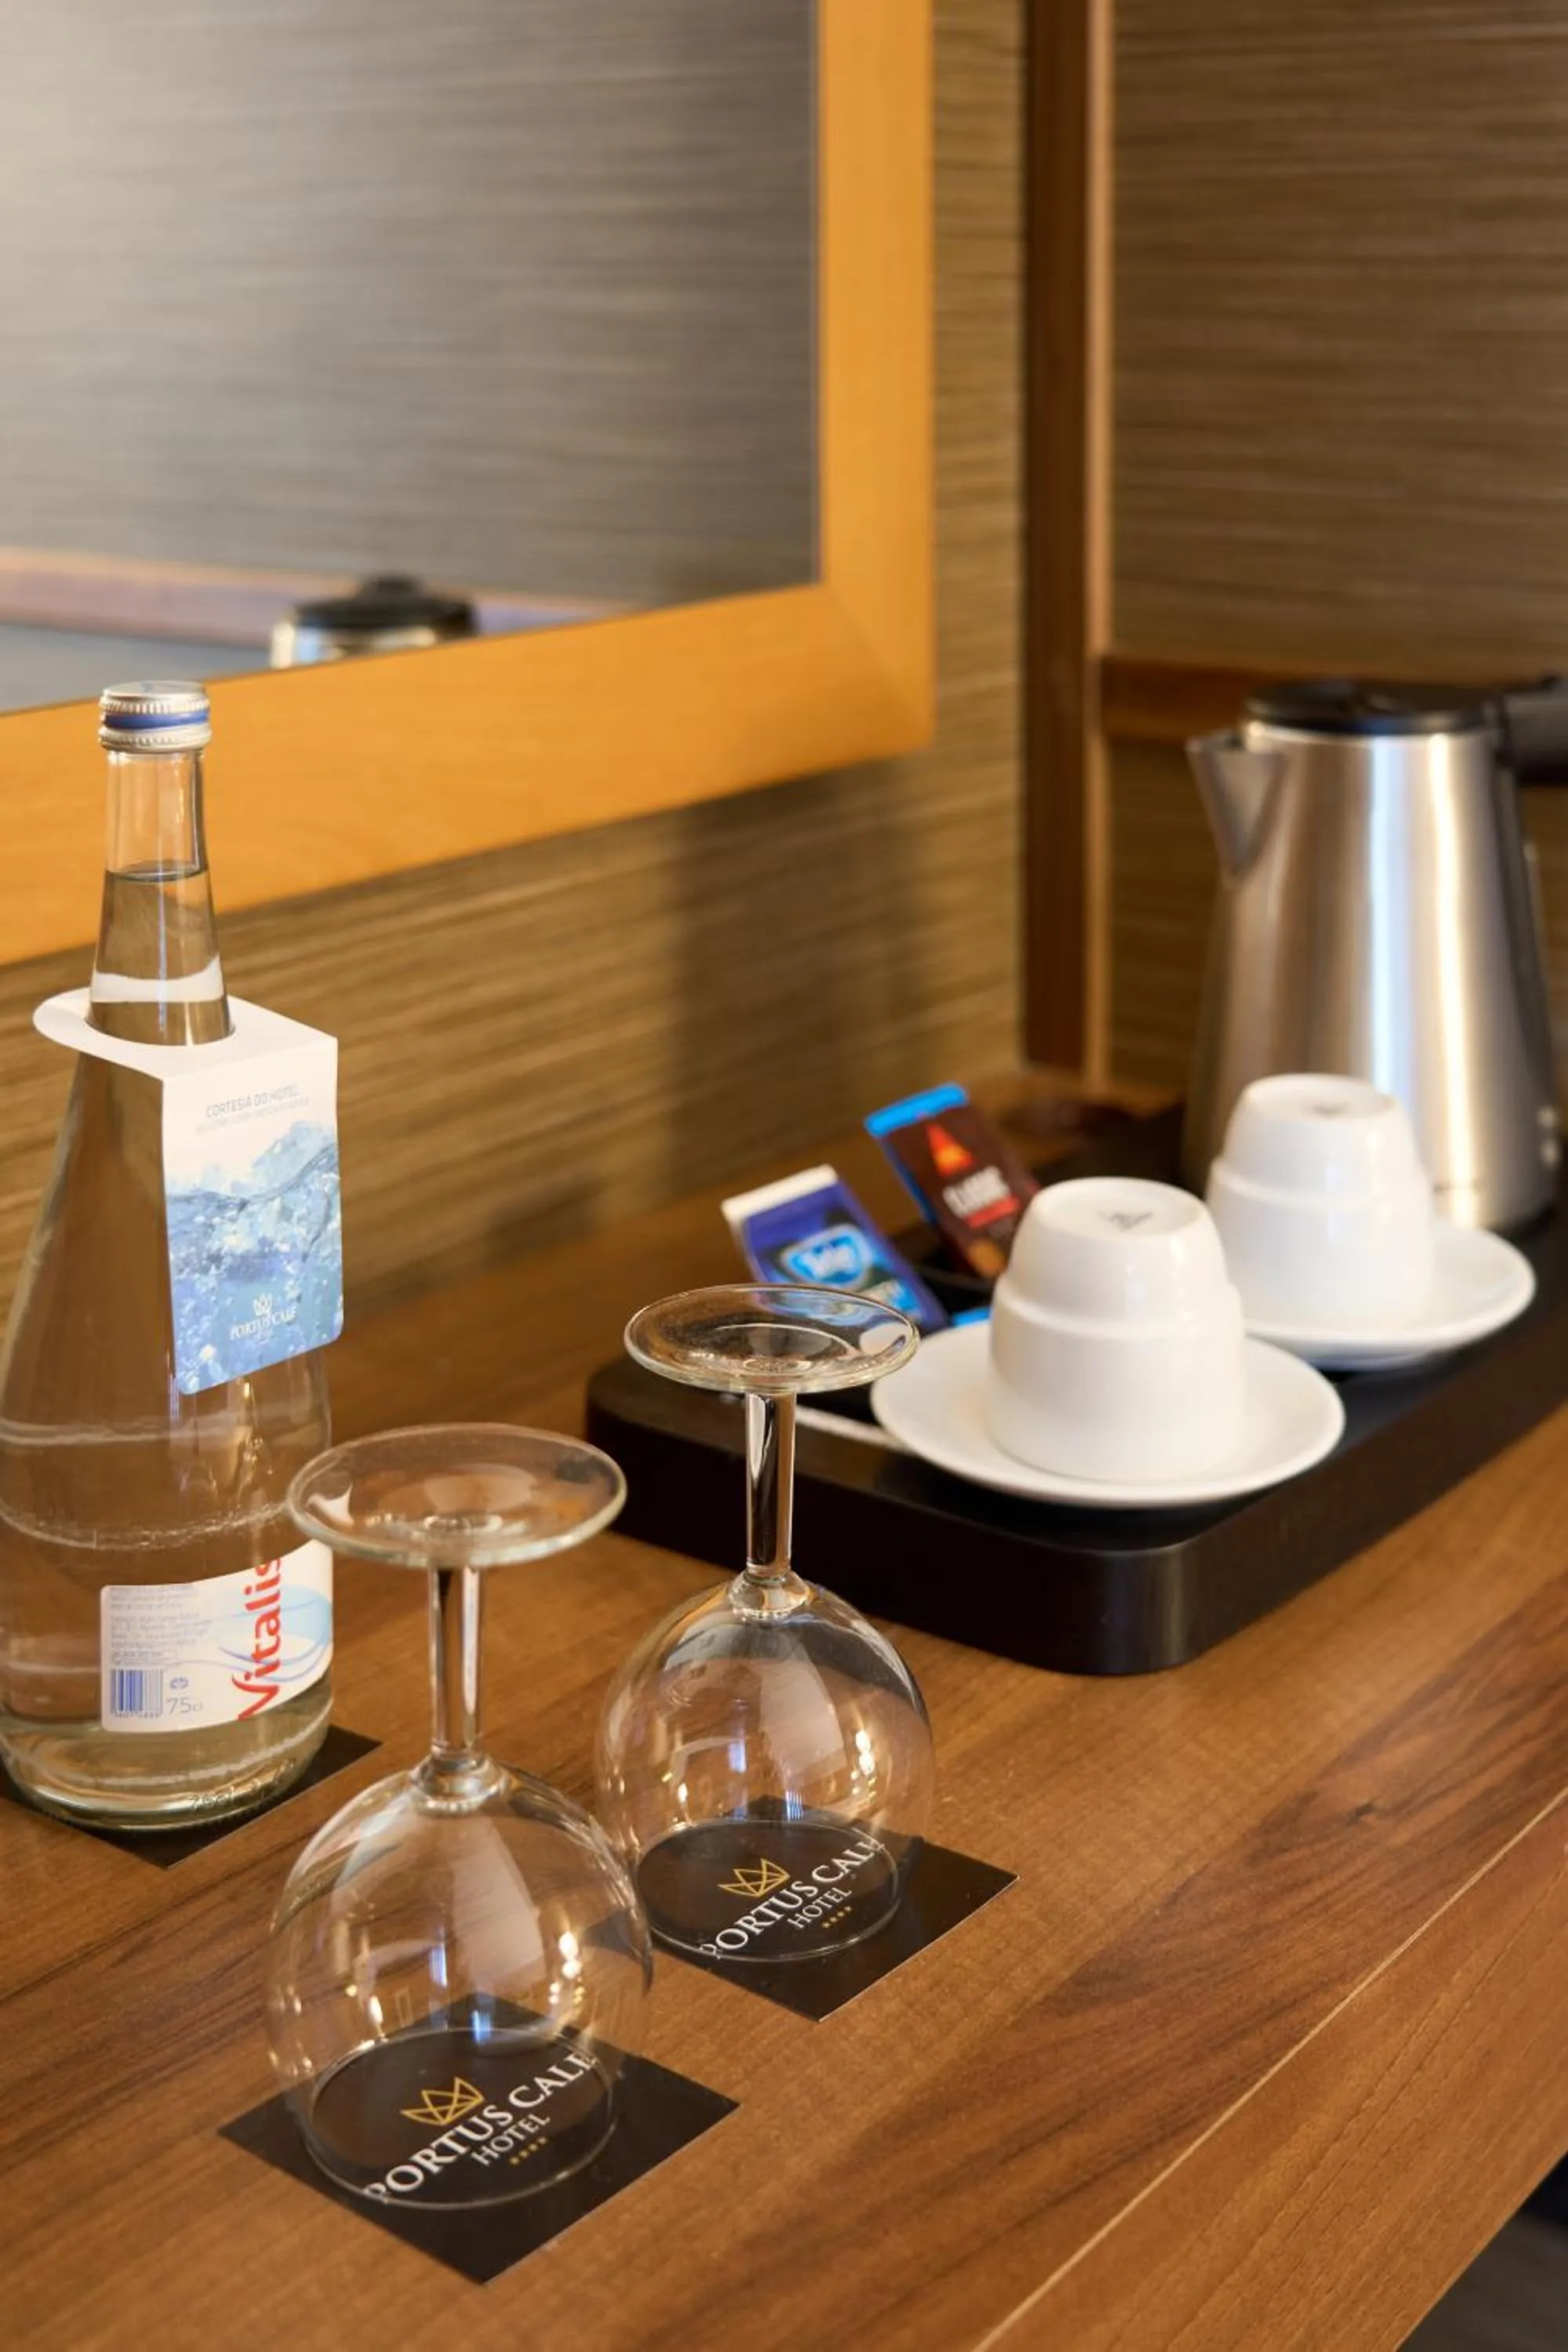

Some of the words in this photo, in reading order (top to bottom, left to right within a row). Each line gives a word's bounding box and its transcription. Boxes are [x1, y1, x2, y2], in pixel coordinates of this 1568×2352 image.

[232, 1558, 281, 1720] Vitalis
[166, 1697, 203, 1715] 75cl
[699, 1881, 818, 1960] PORTUS
[787, 1887, 852, 1929] HOTEL
[363, 2105, 514, 2205] PORTUS
[508, 2049, 596, 2108] CALE
[471, 2114, 550, 2166] HOTEL
